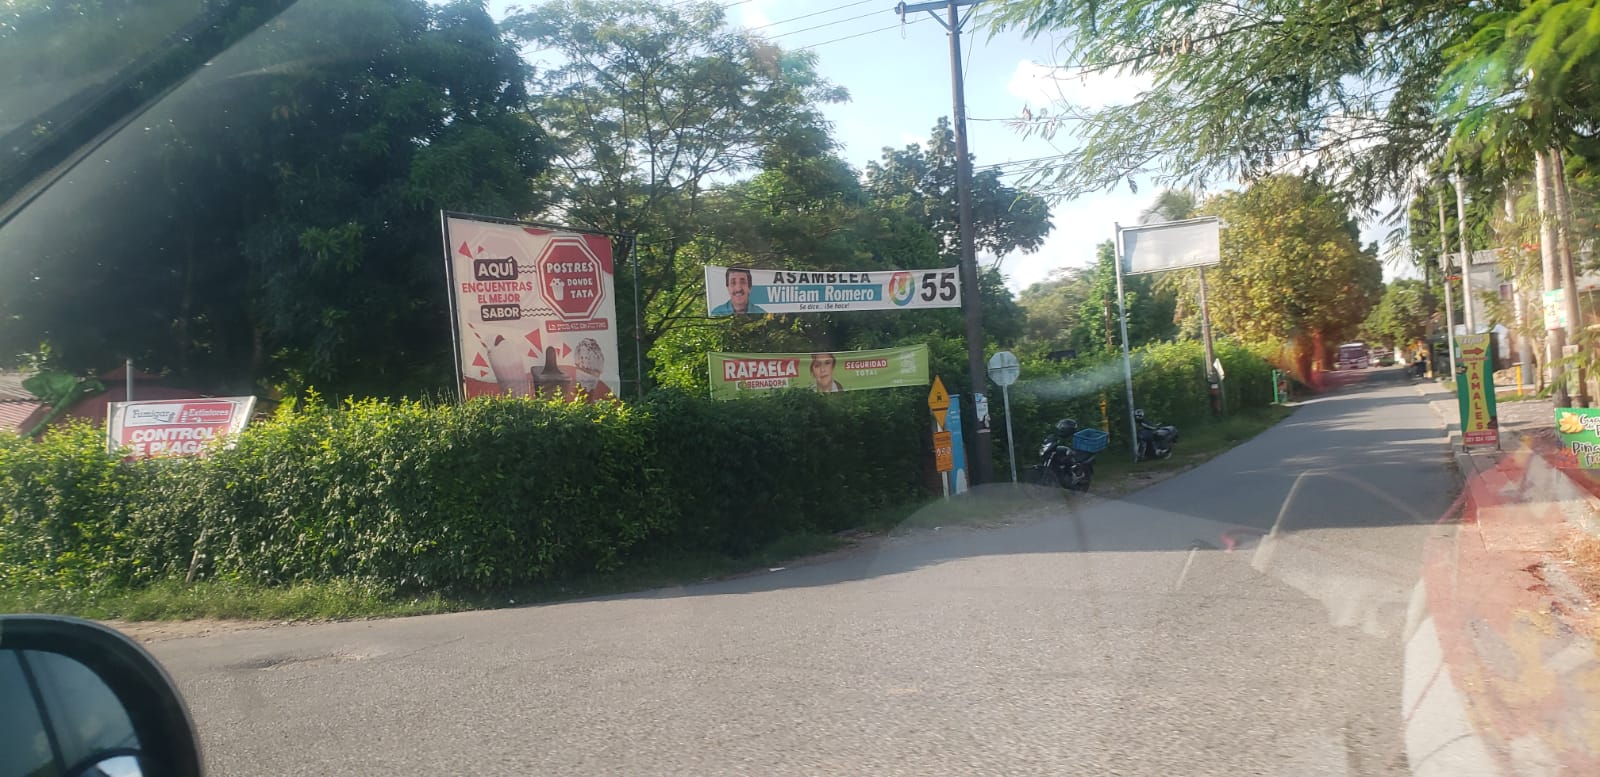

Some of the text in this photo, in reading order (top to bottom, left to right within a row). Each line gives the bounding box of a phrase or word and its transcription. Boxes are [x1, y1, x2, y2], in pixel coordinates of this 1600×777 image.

[478, 256, 514, 278] AQUÍ
[546, 262, 594, 274] POSTRES
[567, 278, 593, 286] DONDE
[773, 272, 871, 284] ASAMBLEA
[462, 280, 532, 293] ENCUENTRAS
[921, 273, 957, 301] 55
[478, 292, 521, 304] EL MEJOR
[570, 289, 594, 299] TATA
[767, 285, 874, 303] William Romero
[482, 305, 520, 319] SABOR
[724, 360, 797, 379] RAFAELA
[845, 360, 887, 370] SEGURIDAD
[855, 369, 878, 377] TOTAL
[1470, 362, 1484, 430] TAMALES
[131, 427, 216, 443] CONTROL
[131, 440, 212, 456] E PLAGA
